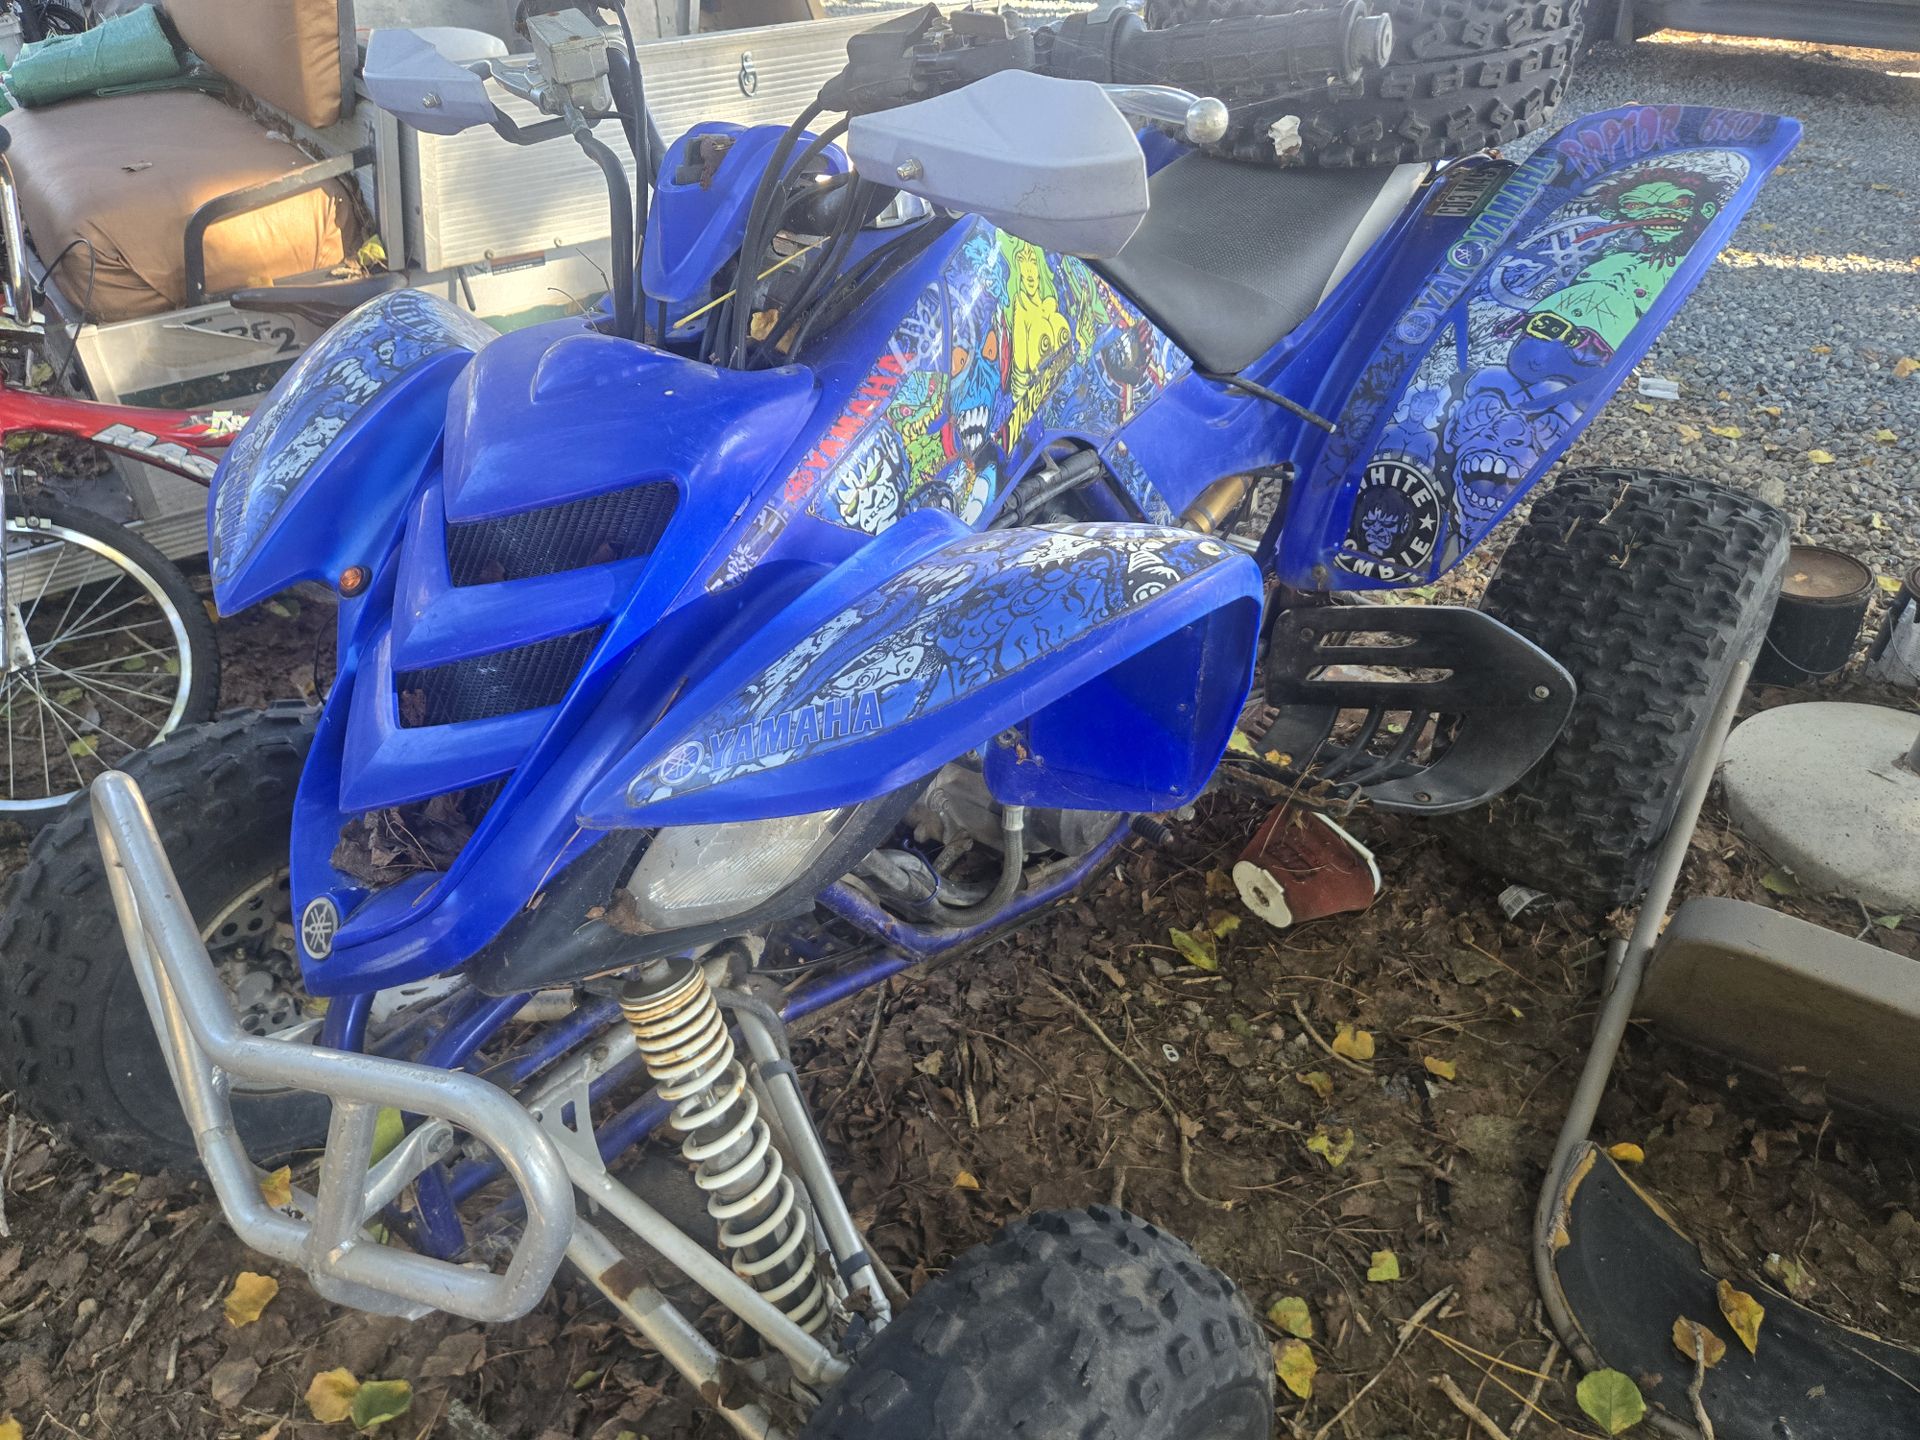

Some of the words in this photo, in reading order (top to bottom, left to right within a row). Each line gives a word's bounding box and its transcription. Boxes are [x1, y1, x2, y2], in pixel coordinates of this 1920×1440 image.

[1556, 104, 1685, 179] RAPTOR
[1463, 156, 1561, 243] YAMAHA
[803, 352, 918, 470] YAMAHA
[1338, 536, 1431, 579] OMBIE
[709, 690, 883, 771] YAMAHA
